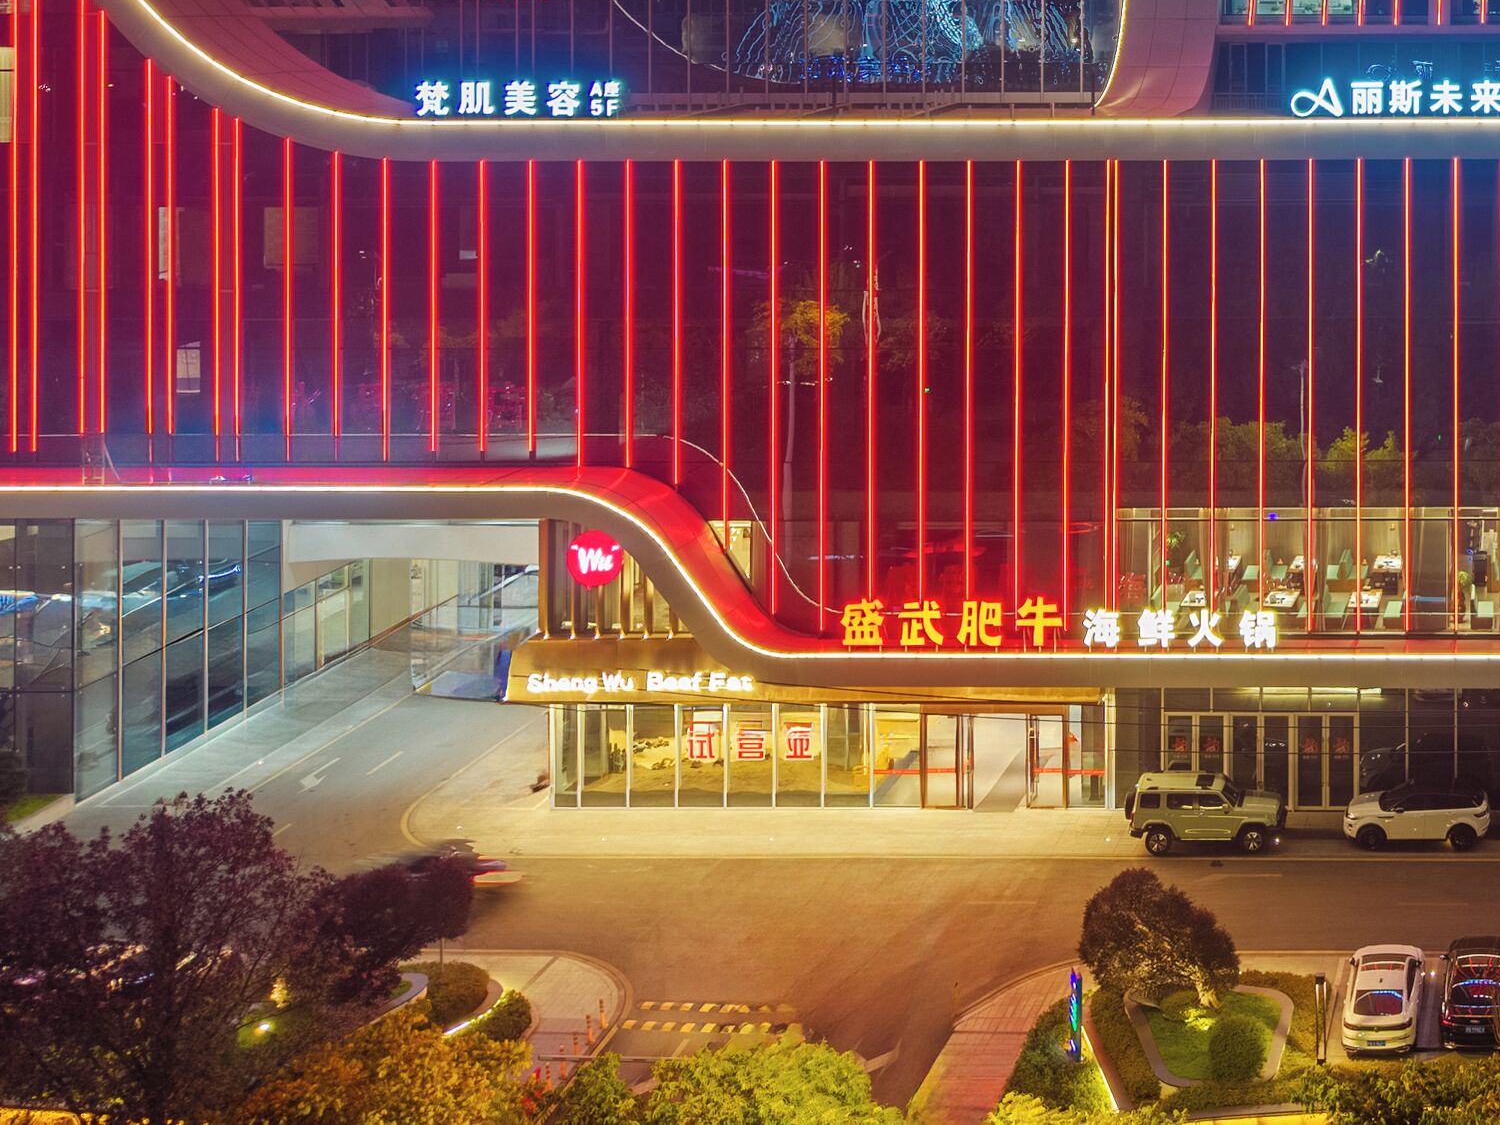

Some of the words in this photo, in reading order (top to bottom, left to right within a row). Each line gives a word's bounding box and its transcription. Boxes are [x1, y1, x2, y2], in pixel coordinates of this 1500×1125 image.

[415, 80, 580, 117] 梵肌美容
[590, 99, 619, 117] 5F
[840, 597, 1063, 647] 盛武肥牛
[1082, 607, 1278, 648] 海鲜火锅
[526, 672, 599, 694] Sheng
[602, 672, 634, 691] Wu
[646, 671, 702, 692] Beef
